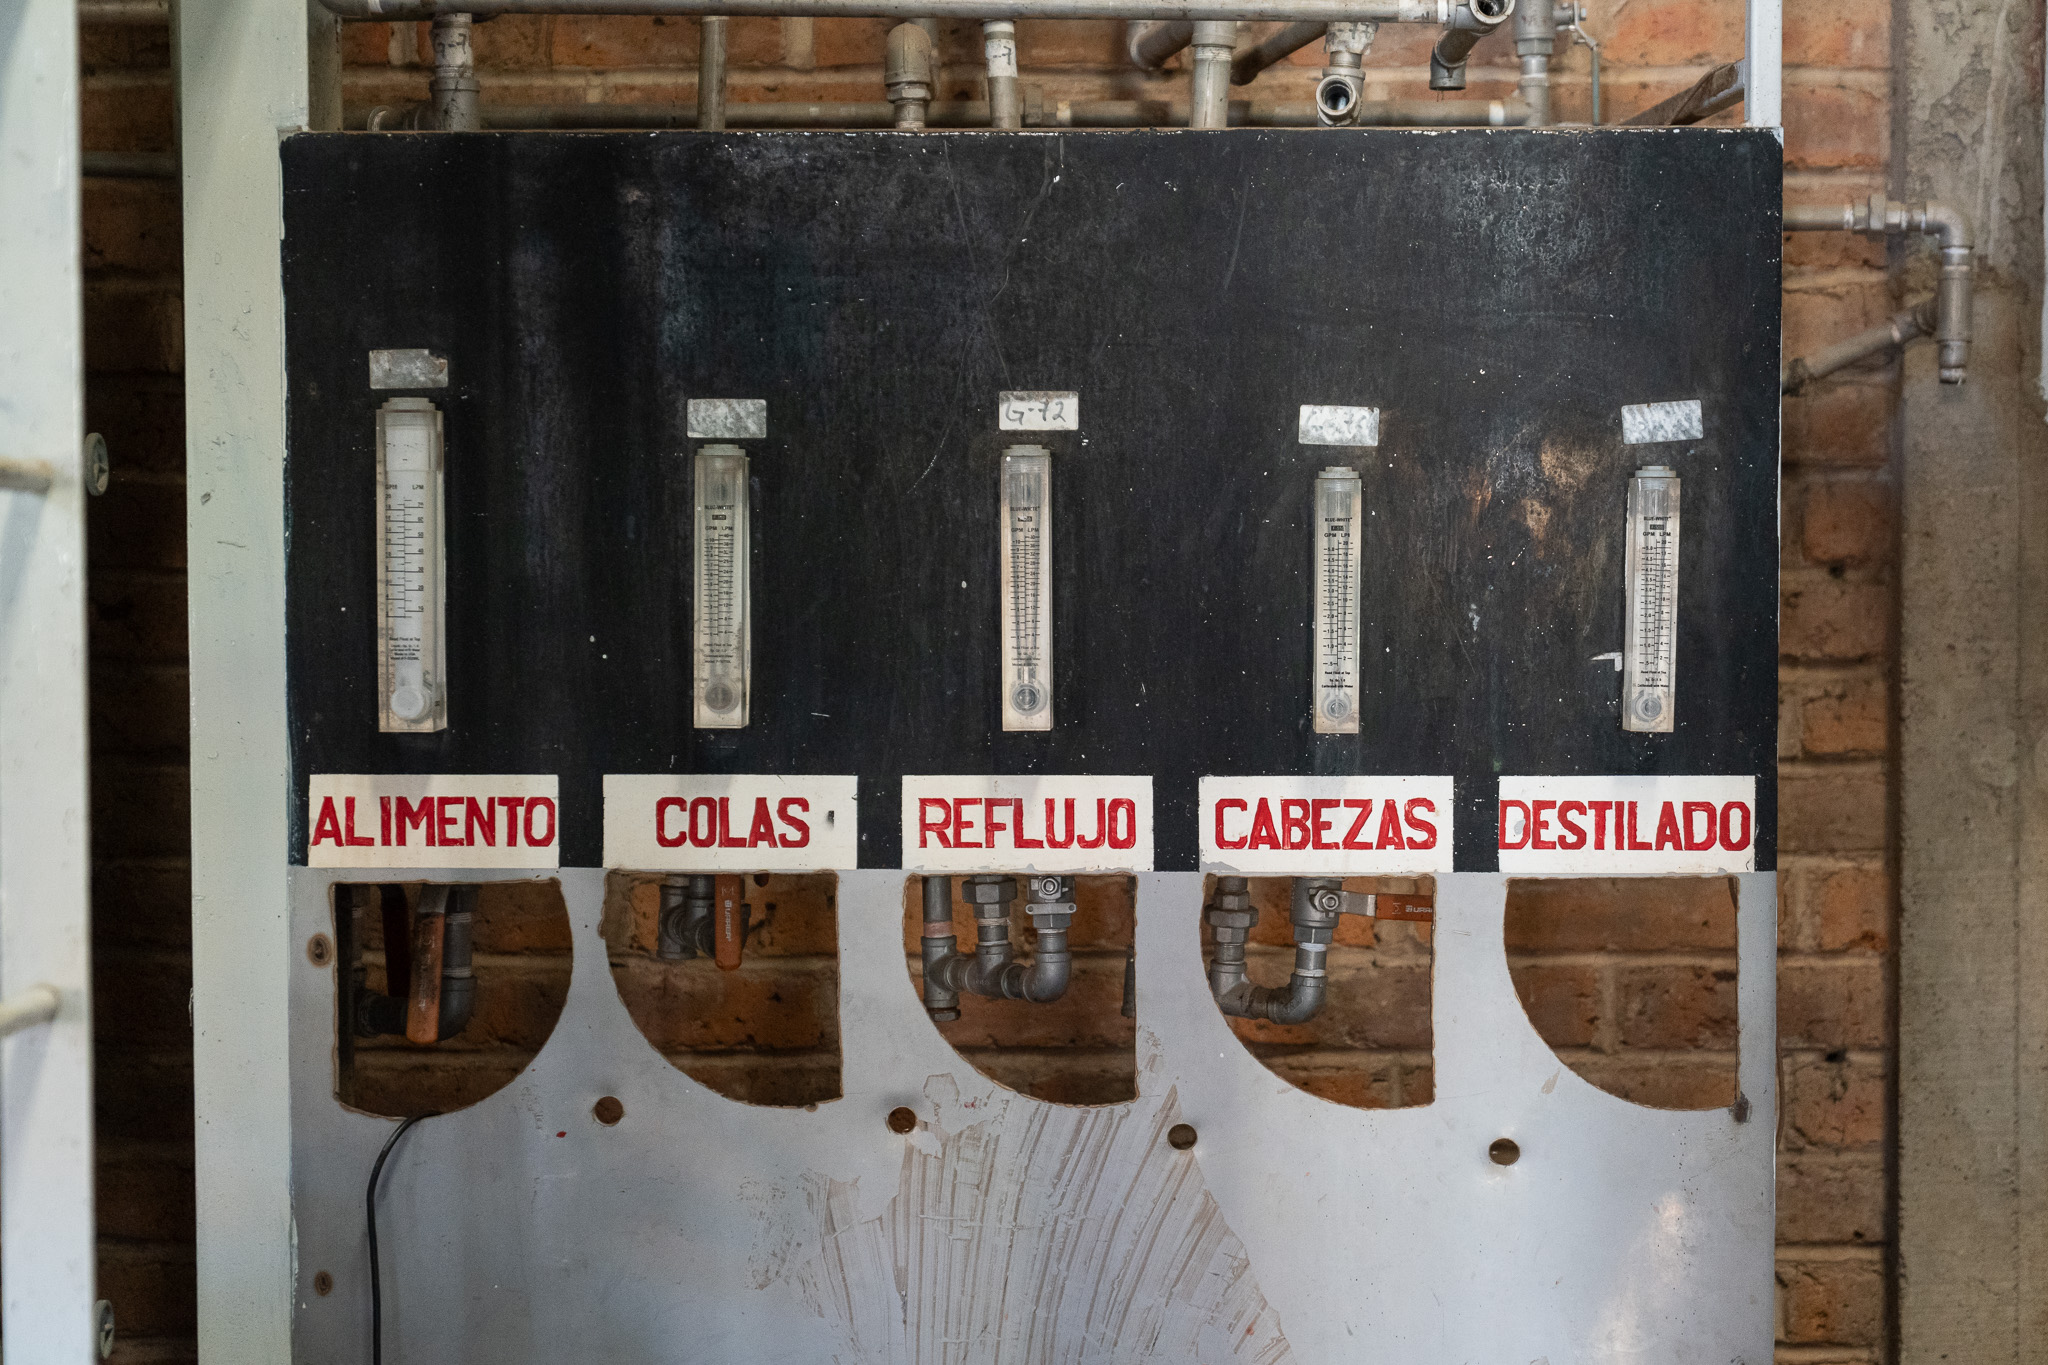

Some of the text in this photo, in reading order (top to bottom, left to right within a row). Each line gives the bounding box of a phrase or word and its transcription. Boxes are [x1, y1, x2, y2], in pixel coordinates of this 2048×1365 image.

[1006, 400, 1066, 425] G-72
[311, 796, 556, 848] ALIMENTO
[655, 796, 811, 849] COLAS
[918, 797, 1137, 849] REFLUJO
[1214, 797, 1438, 850] CABEZAS
[1498, 799, 1752, 852] DESTILADO
